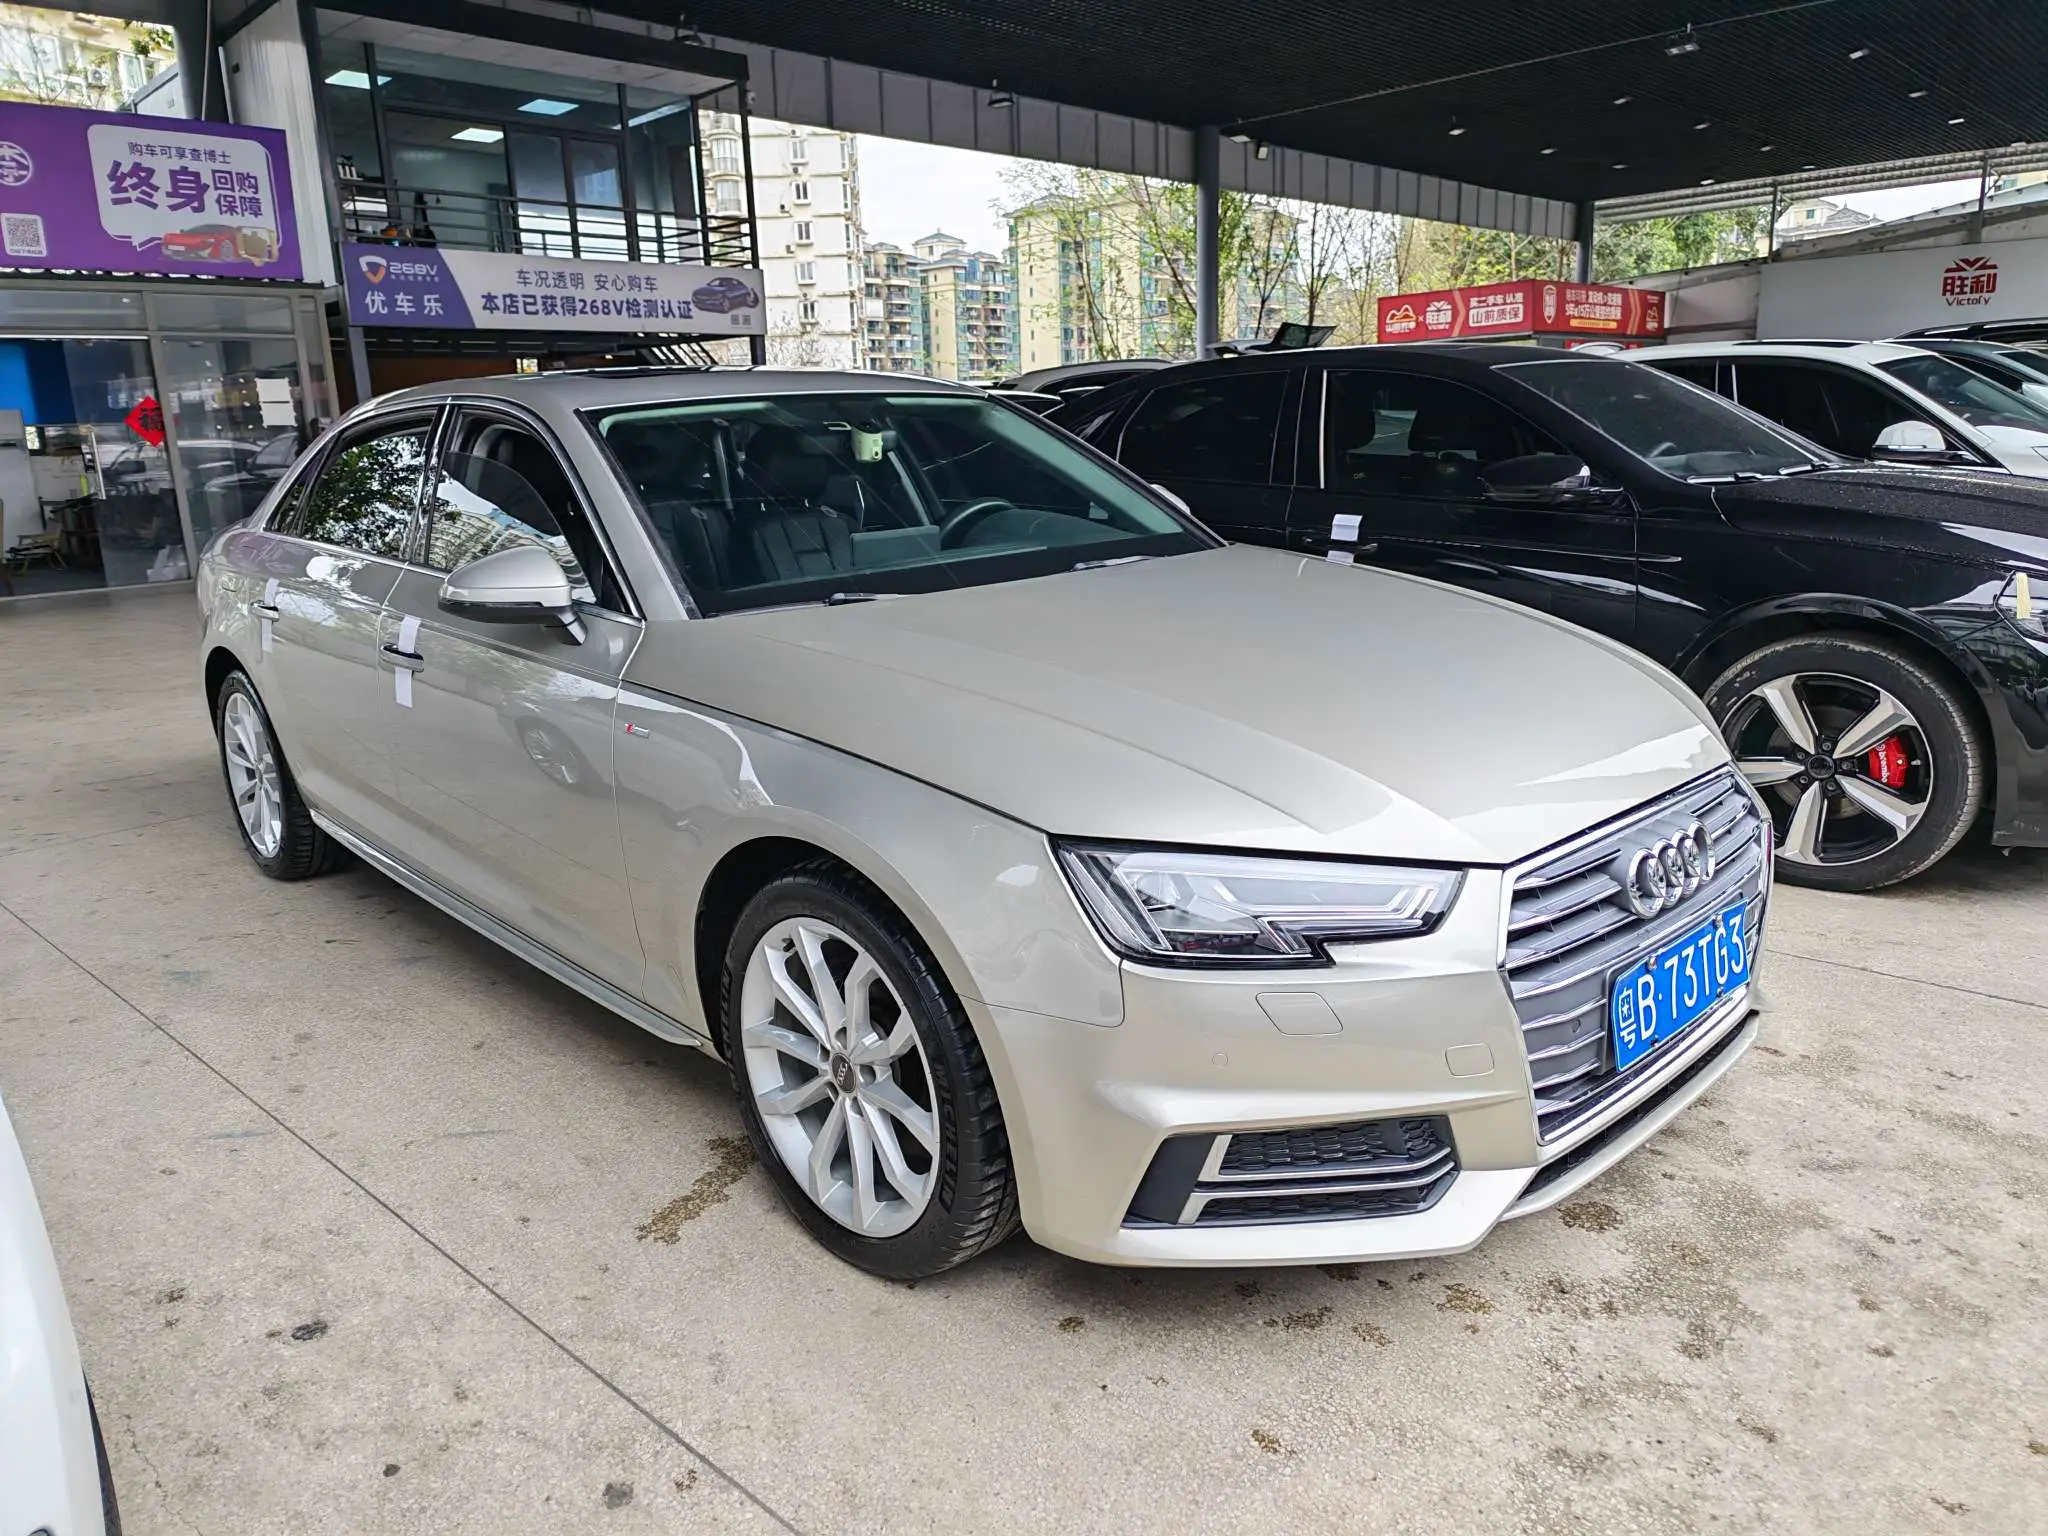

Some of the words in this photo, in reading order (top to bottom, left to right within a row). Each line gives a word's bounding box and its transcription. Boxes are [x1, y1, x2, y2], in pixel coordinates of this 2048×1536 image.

[127, 142, 232, 165] 购车可享查博士
[106, 160, 210, 213] 终身
[211, 169, 259, 195] 回购
[215, 193, 263, 218] 保障
[389, 262, 438, 276] 268V
[516, 268, 585, 290] 车况透明
[594, 273, 658, 293] 安心购车
[1941, 273, 1998, 297] 胜利
[365, 289, 444, 316] 优车乐
[481, 291, 694, 319] 本店已获得268V检测认证
[1471, 307, 1521, 324] 山前质保
[933, 1062, 958, 1207] MICHELIN
